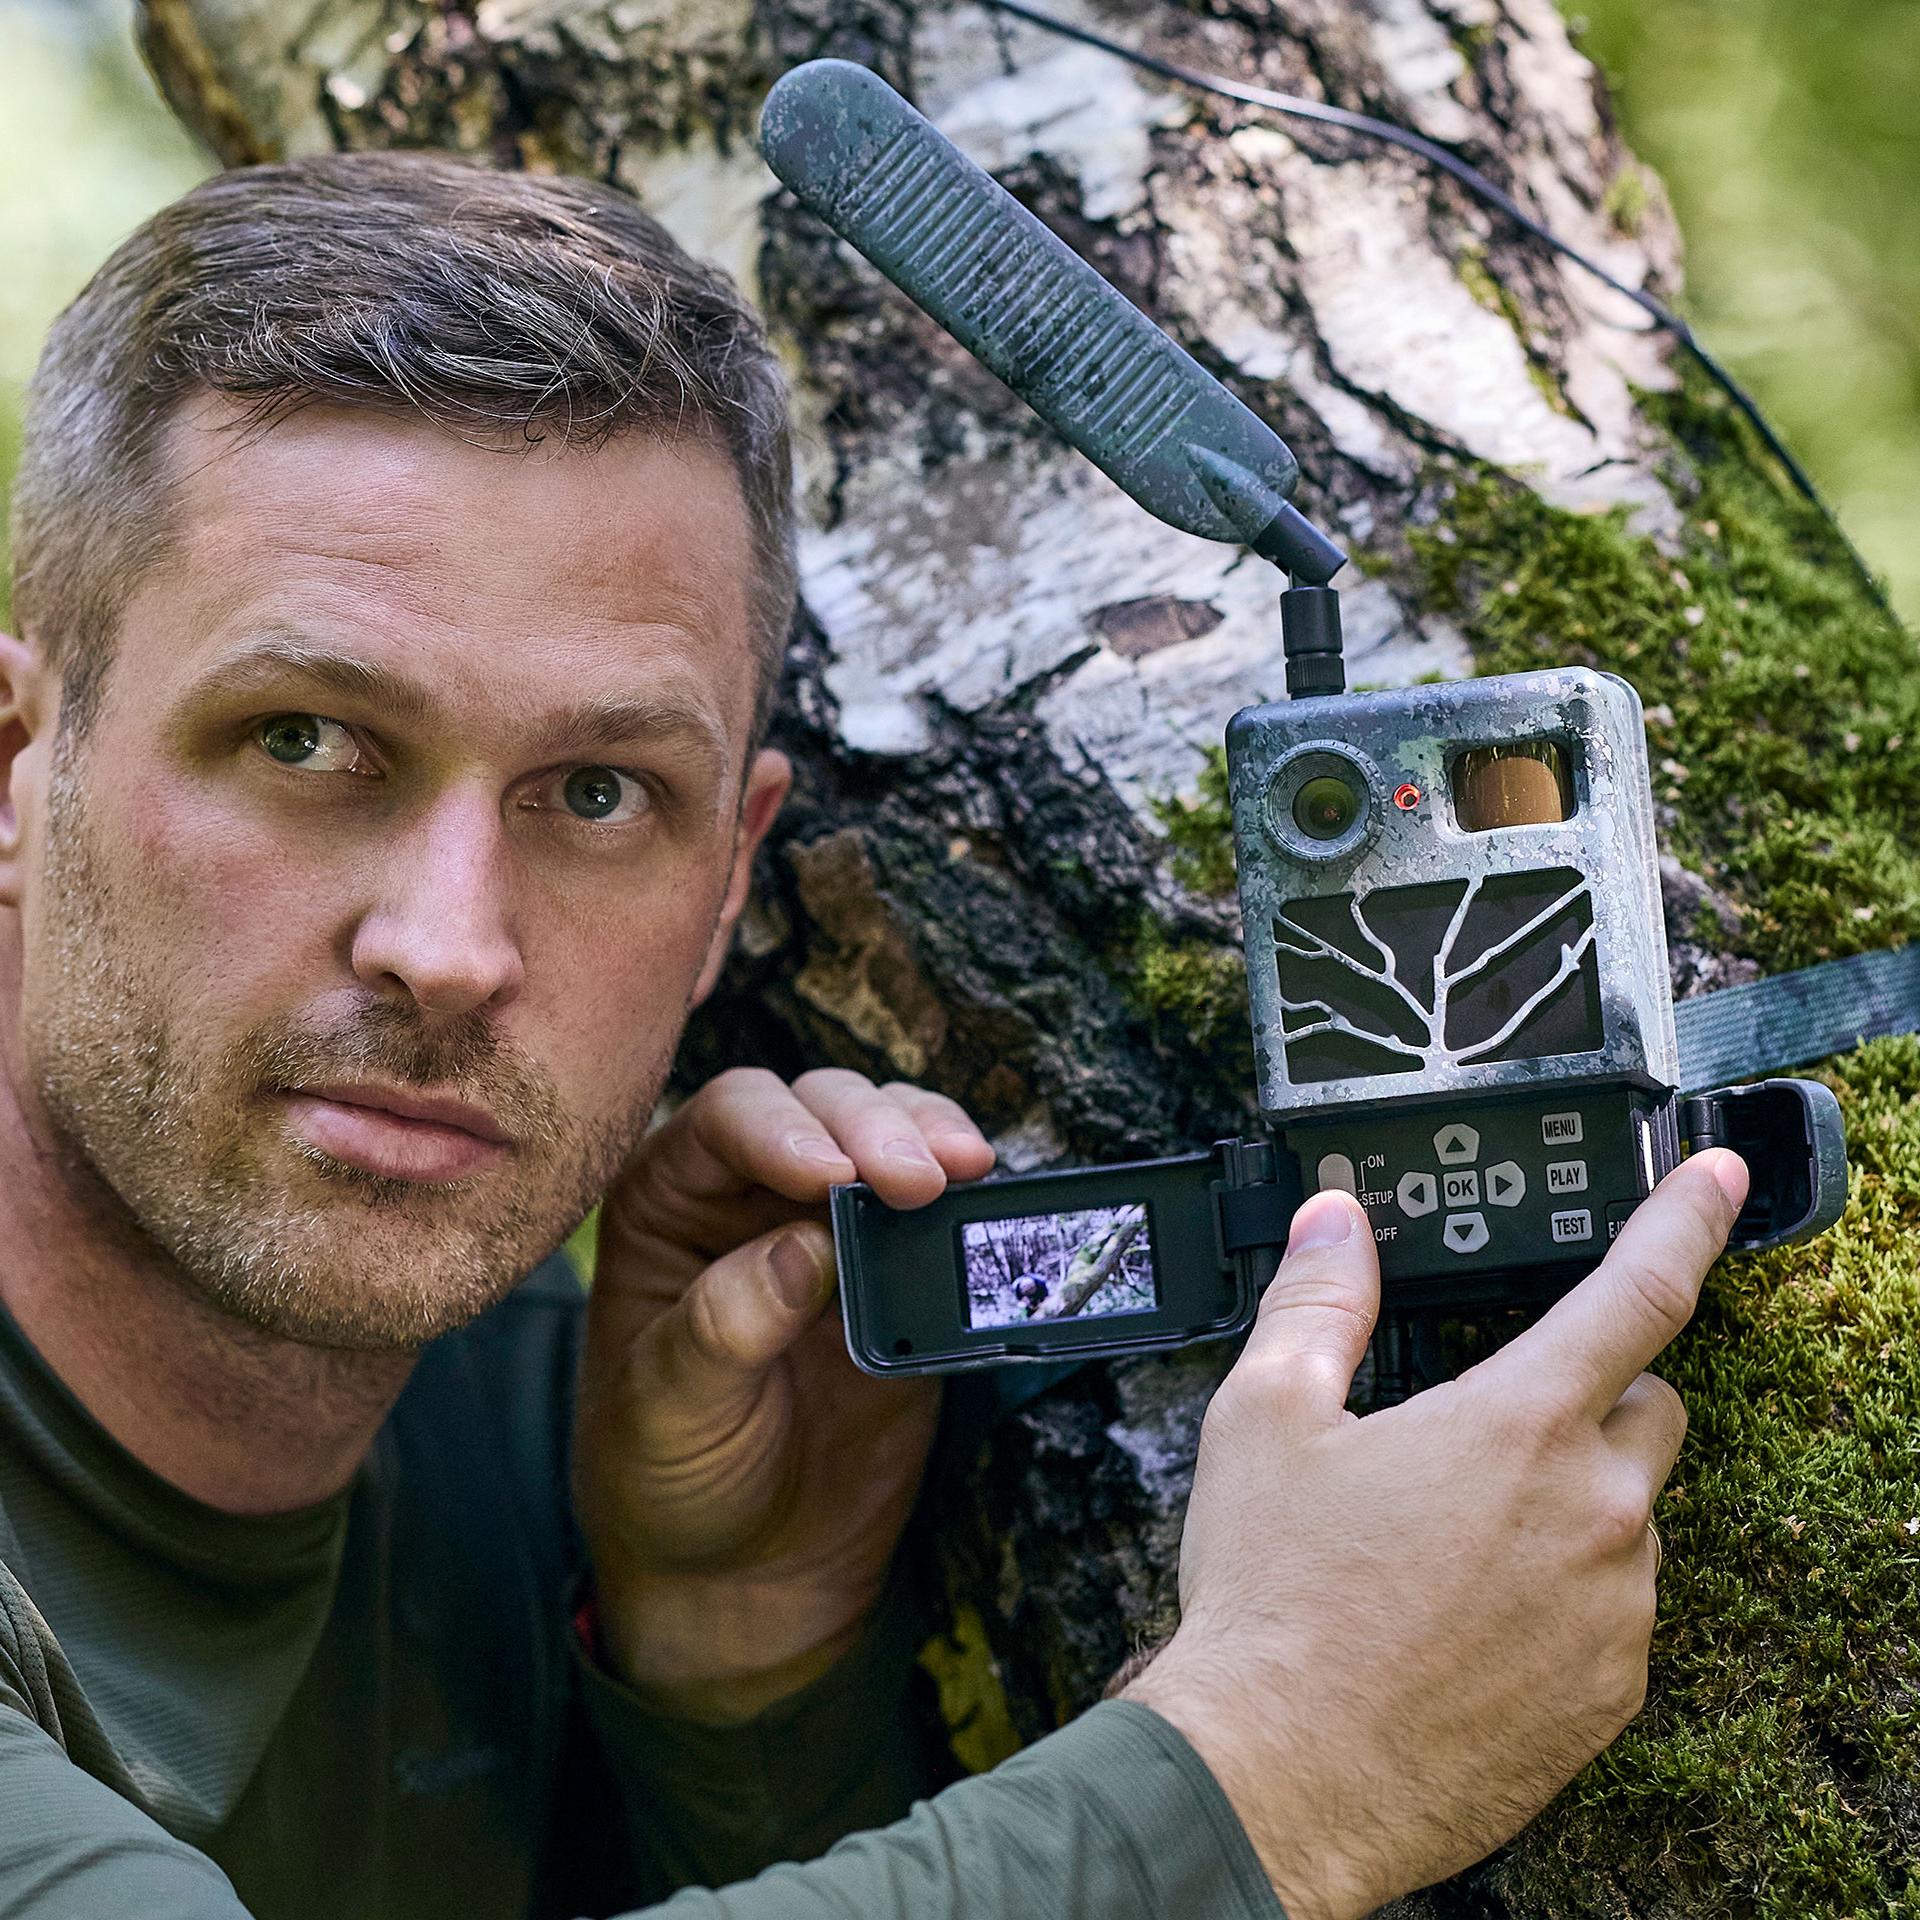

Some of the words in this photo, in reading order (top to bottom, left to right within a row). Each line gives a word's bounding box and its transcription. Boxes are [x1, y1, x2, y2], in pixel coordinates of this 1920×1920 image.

[1544, 1119, 1576, 1138] MENU
[1367, 1154, 1385, 1168] ON
[1550, 1167, 1580, 1187] PLAY
[1447, 1178, 1475, 1197] OK
[1361, 1190, 1394, 1206] SETUP
[1375, 1226, 1398, 1242] OFF
[1554, 1216, 1586, 1236] TEST
